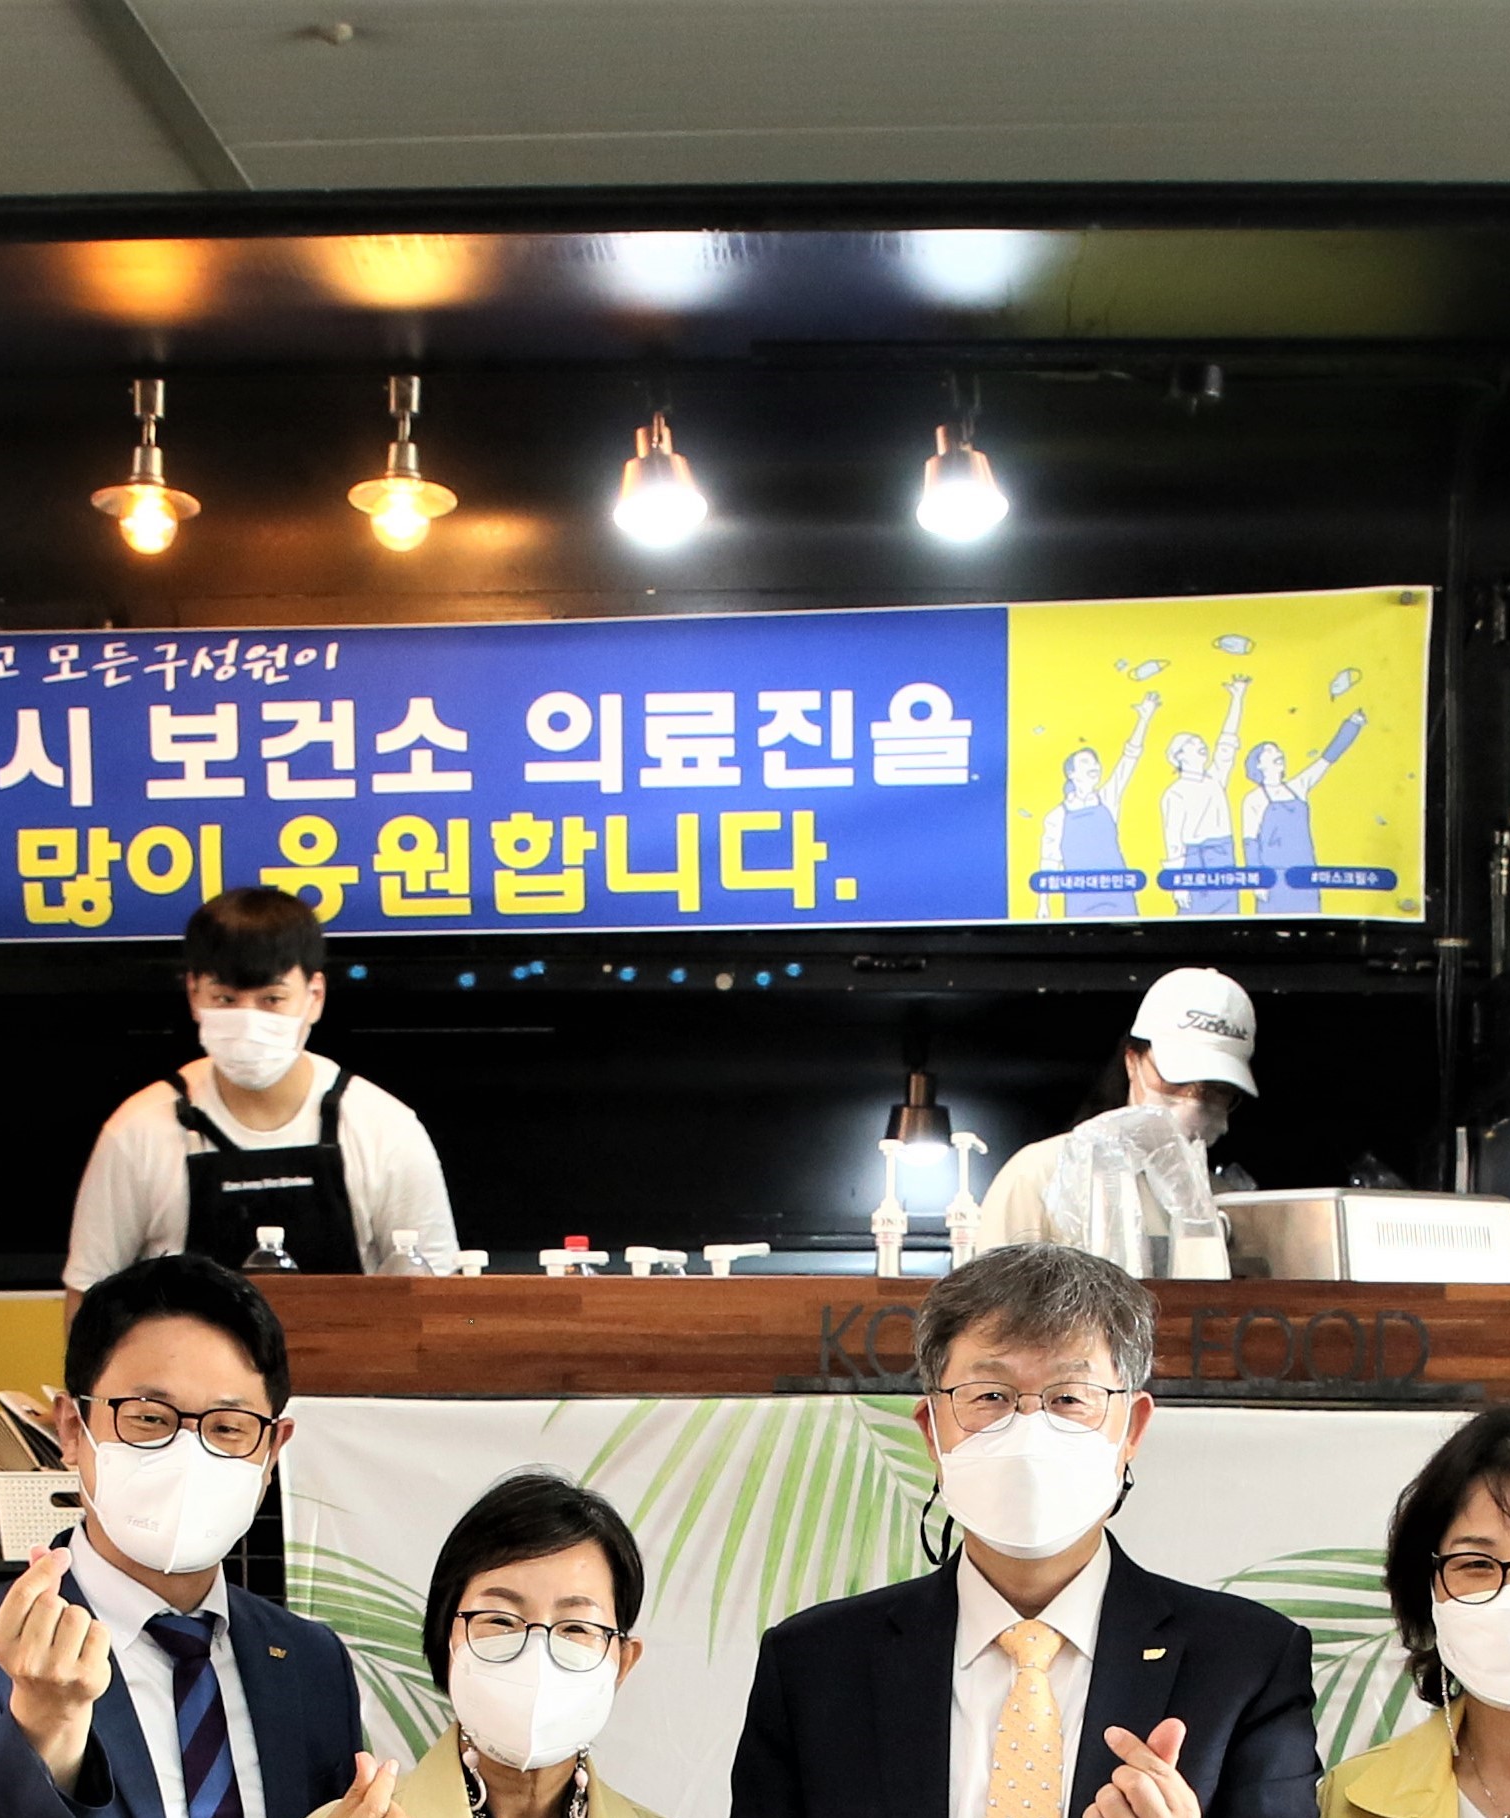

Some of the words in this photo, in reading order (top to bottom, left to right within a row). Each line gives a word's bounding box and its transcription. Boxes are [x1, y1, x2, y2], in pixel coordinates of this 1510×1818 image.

[147, 698, 472, 800] 보건소
[523, 681, 973, 794] 의료진을
[18, 824, 223, 927] 많이
[258, 812, 857, 922] 응원합니다.
[1191, 1308, 1430, 1385] FOOD
